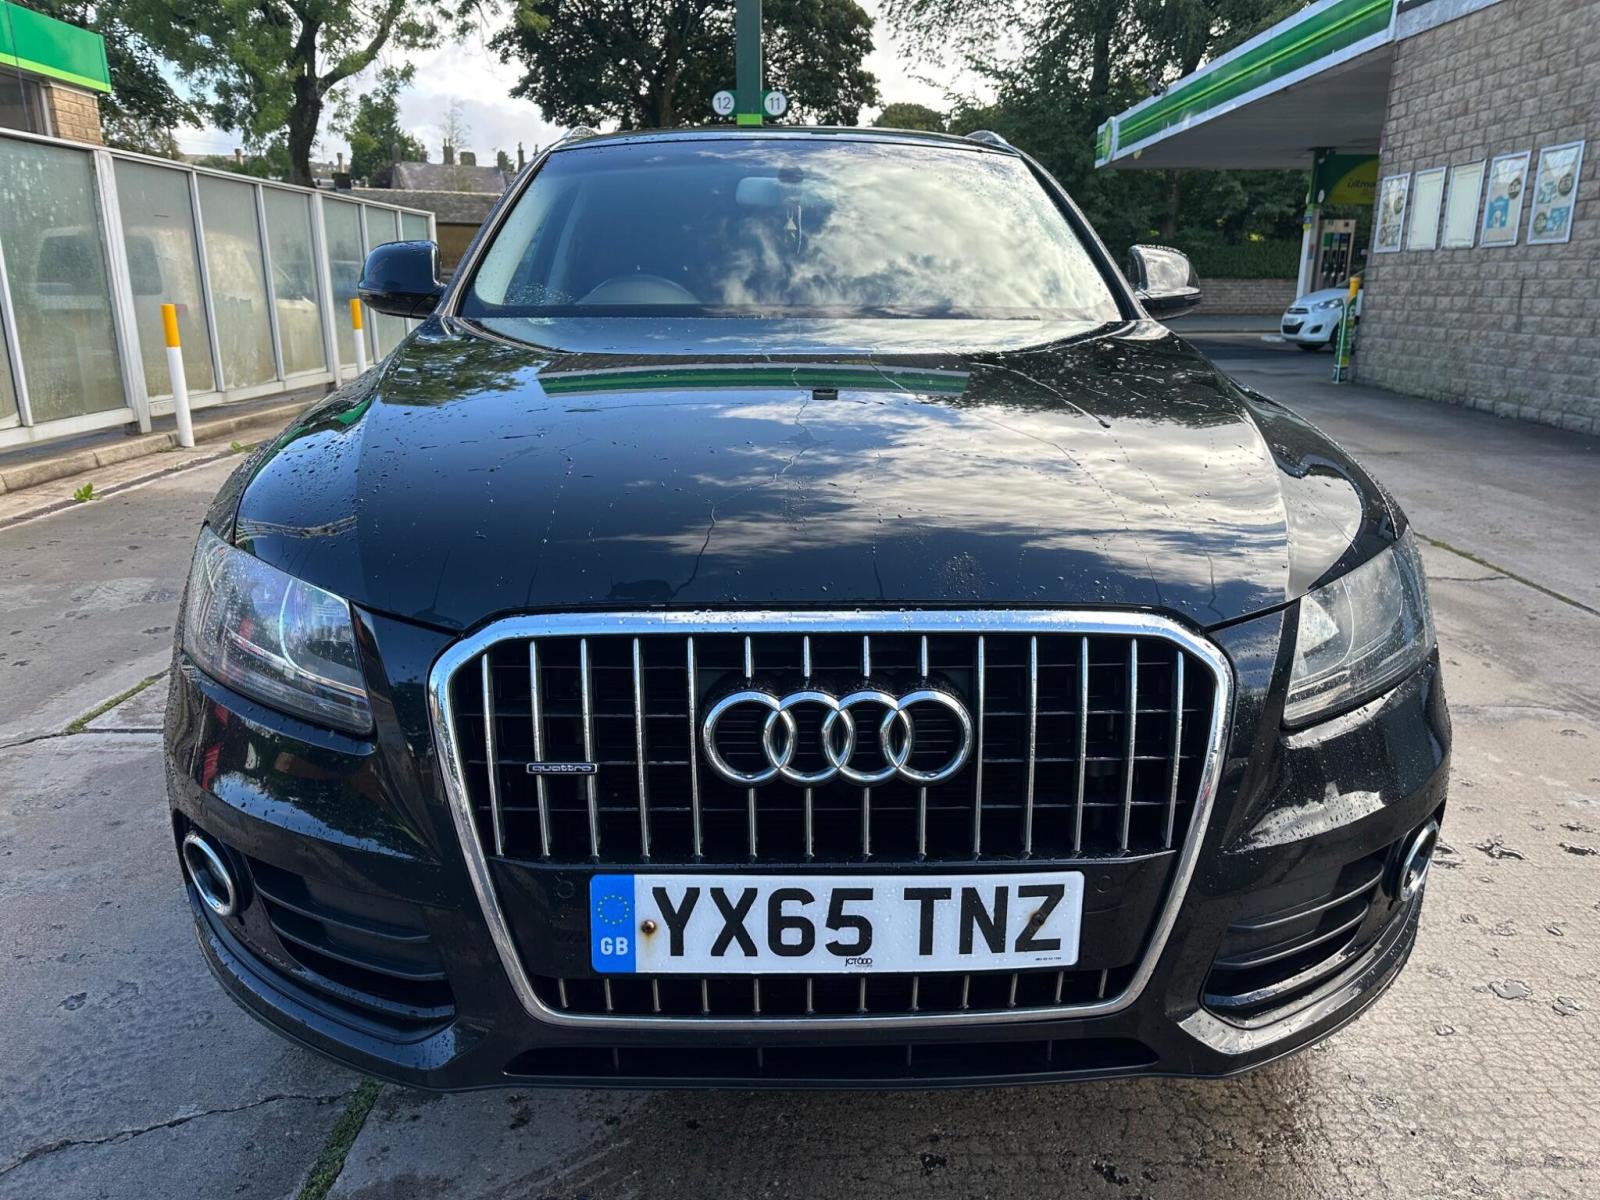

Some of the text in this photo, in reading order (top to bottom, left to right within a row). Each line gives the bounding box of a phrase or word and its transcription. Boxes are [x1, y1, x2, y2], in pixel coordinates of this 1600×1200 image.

[716, 96, 731, 110] 12
[769, 97, 781, 111] 11
[532, 765, 592, 773] quattro
[652, 884, 1065, 956] YX65 TNZ
[600, 936, 628, 956] GB
